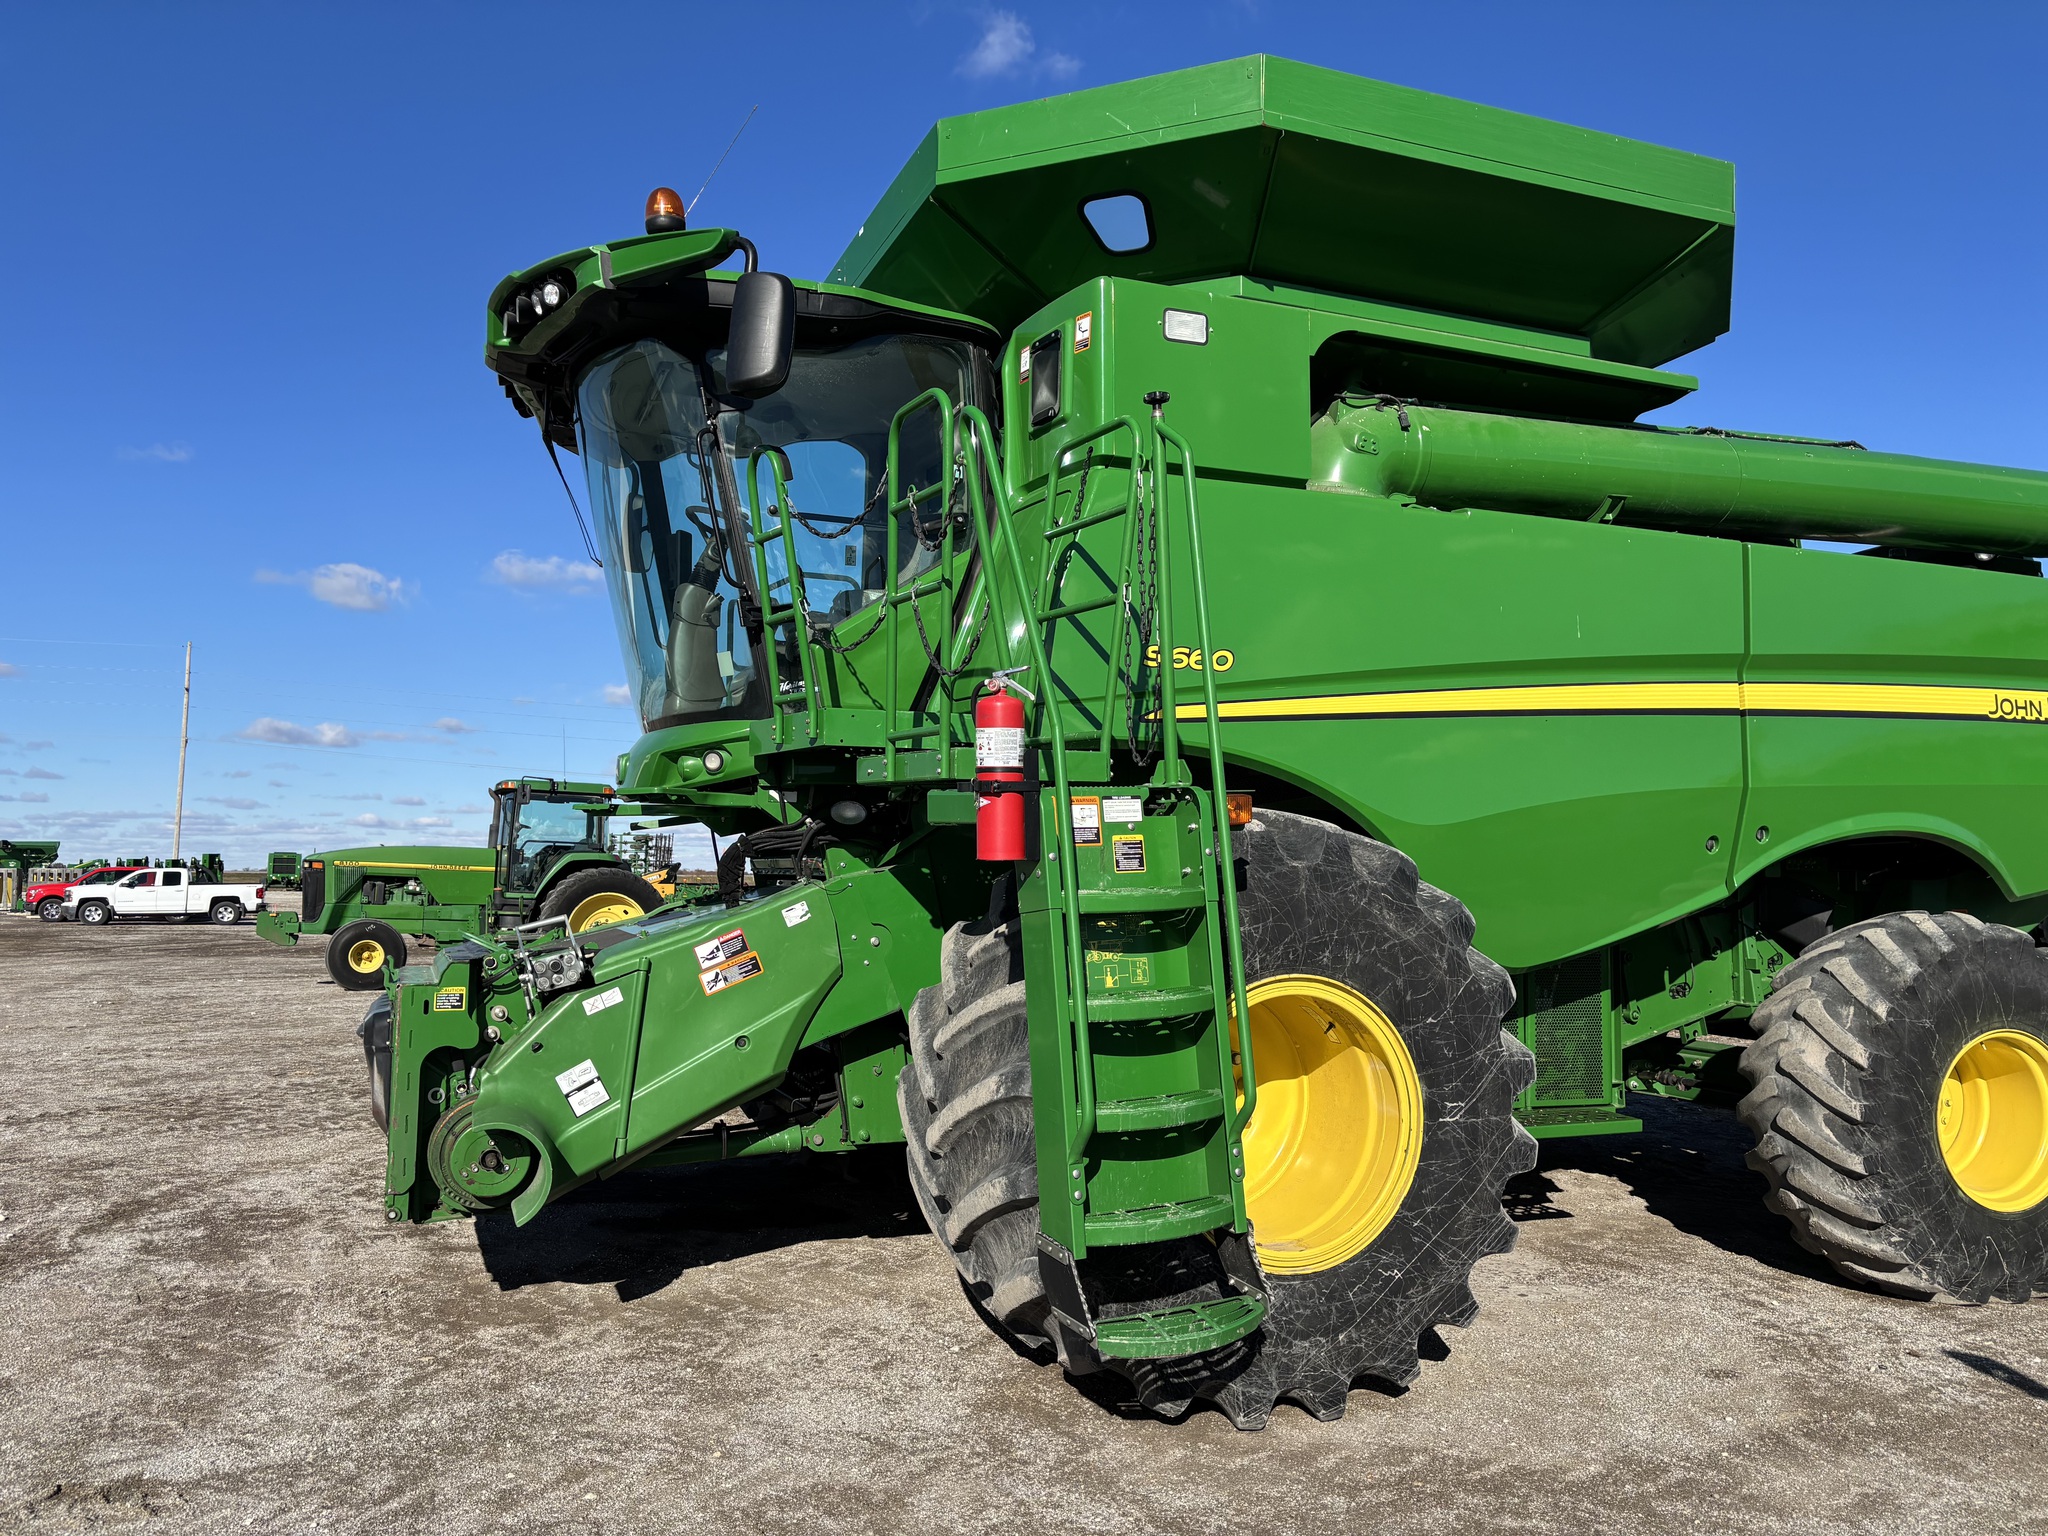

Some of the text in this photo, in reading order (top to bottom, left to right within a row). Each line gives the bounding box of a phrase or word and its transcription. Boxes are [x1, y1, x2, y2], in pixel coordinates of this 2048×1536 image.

[1143, 644, 1235, 673] S660
[779, 680, 806, 692] Heritag
[1988, 693, 2043, 717] JOHN
